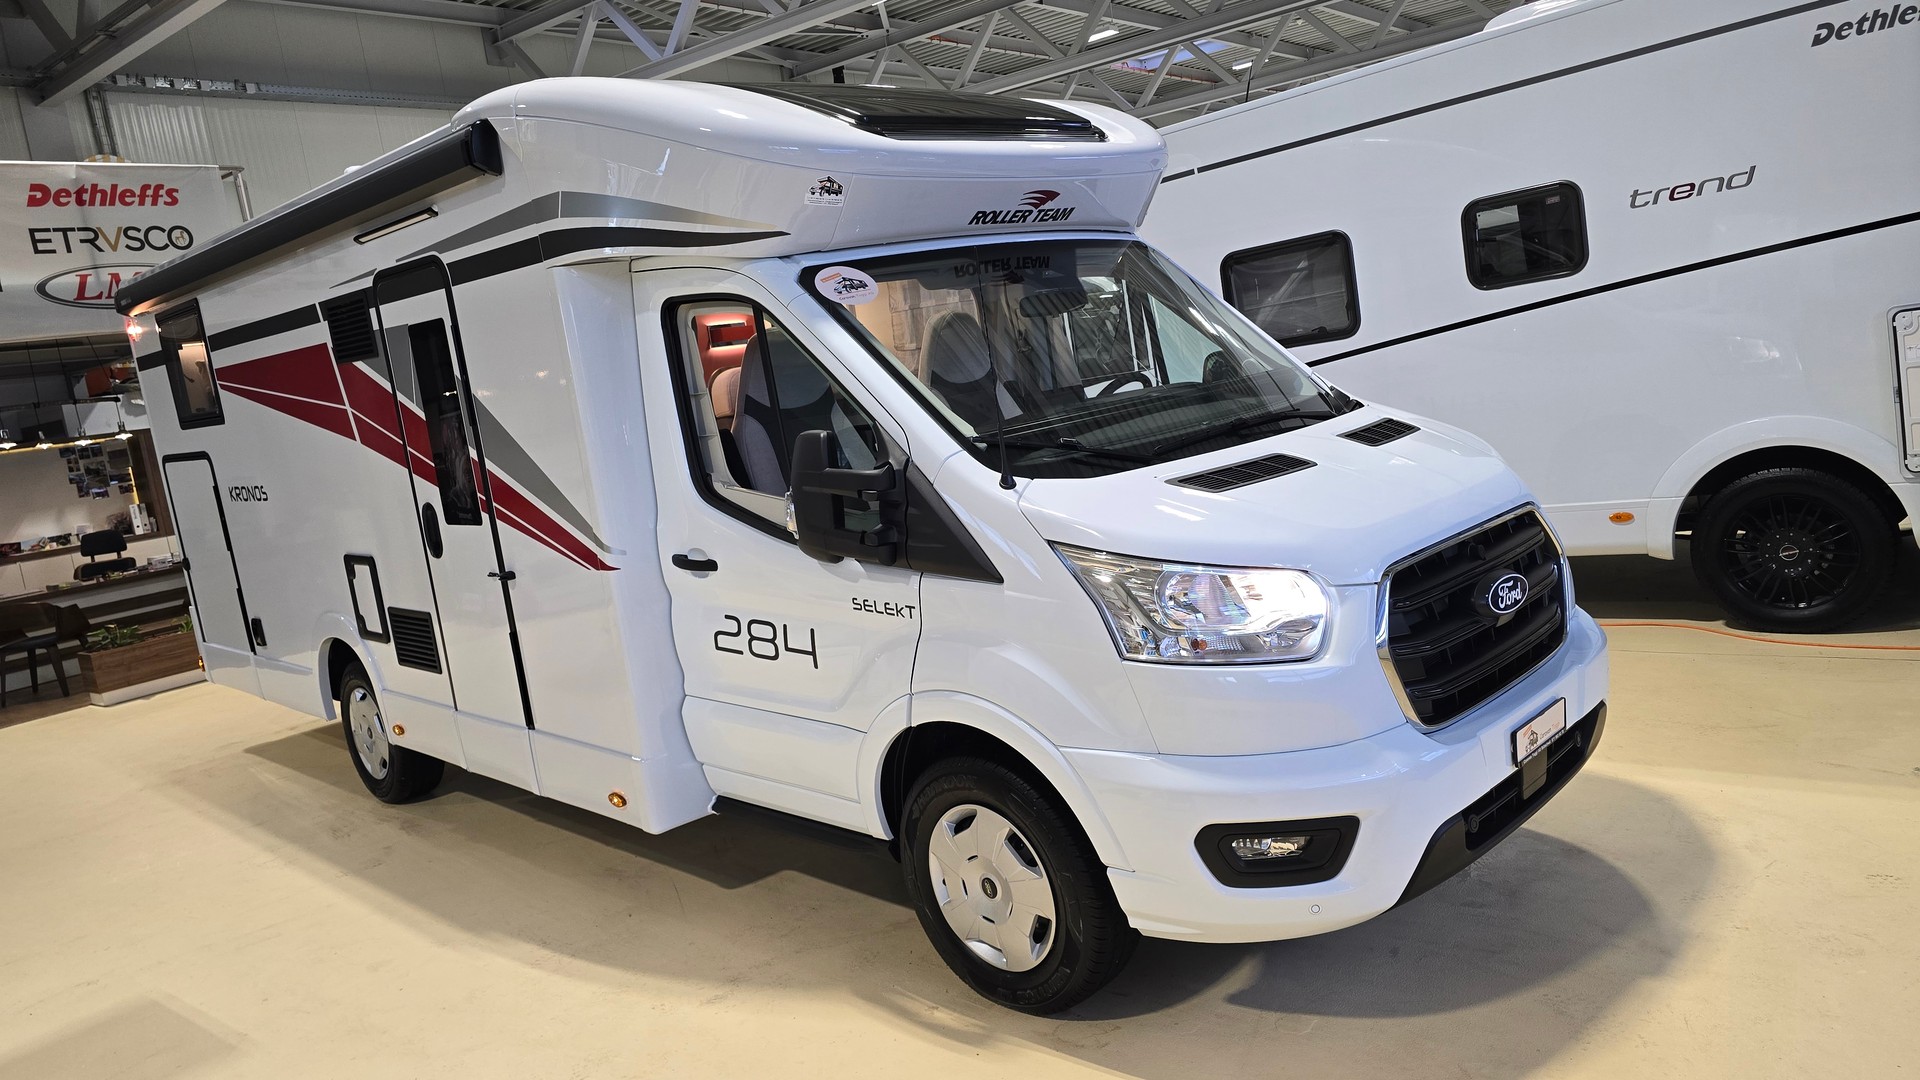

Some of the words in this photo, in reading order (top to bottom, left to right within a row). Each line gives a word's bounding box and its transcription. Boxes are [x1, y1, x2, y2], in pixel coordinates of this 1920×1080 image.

[1811, 3, 1920, 47] Dethle
[26, 183, 179, 208] Dethleffs
[1629, 165, 1756, 209] trend
[967, 209, 1034, 226] ROLLER
[1032, 206, 1077, 223] TEAM
[227, 485, 269, 502] KRONOS
[1498, 580, 1523, 608] Ford
[852, 597, 916, 619] SELEKT
[713, 614, 819, 669] 284
